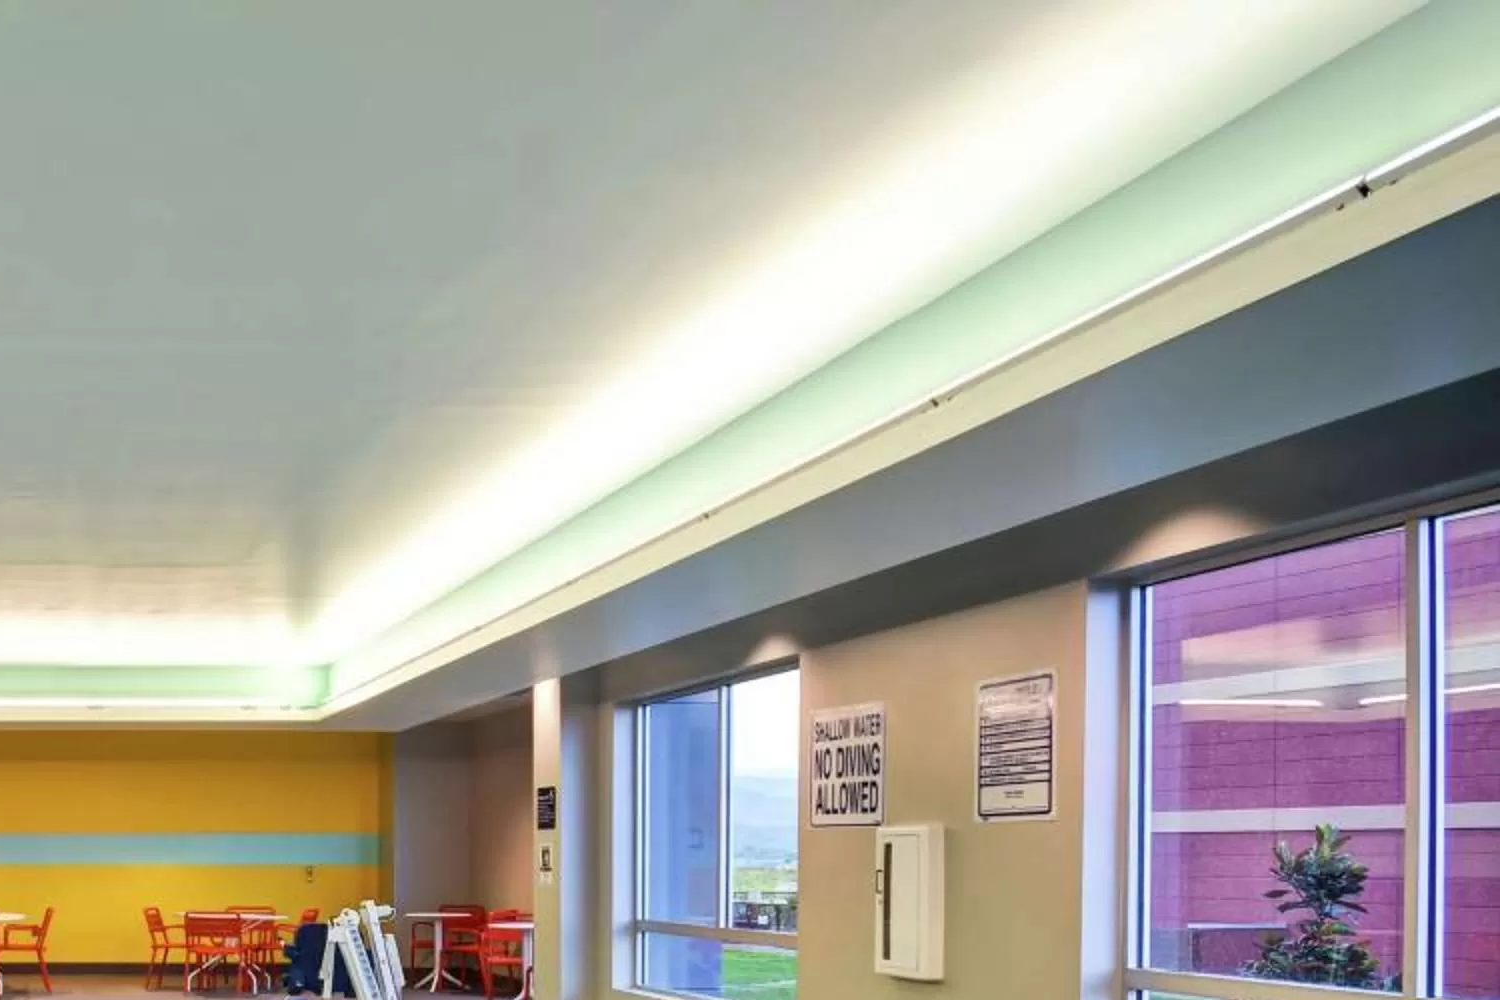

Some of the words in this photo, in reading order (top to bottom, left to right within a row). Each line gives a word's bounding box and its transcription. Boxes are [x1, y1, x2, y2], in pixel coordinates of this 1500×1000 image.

[815, 718, 850, 743] SHALLOW
[854, 713, 881, 737] WATER
[814, 746, 832, 779] NO
[836, 742, 880, 778] DIVING
[815, 781, 879, 815] ALLOWED
